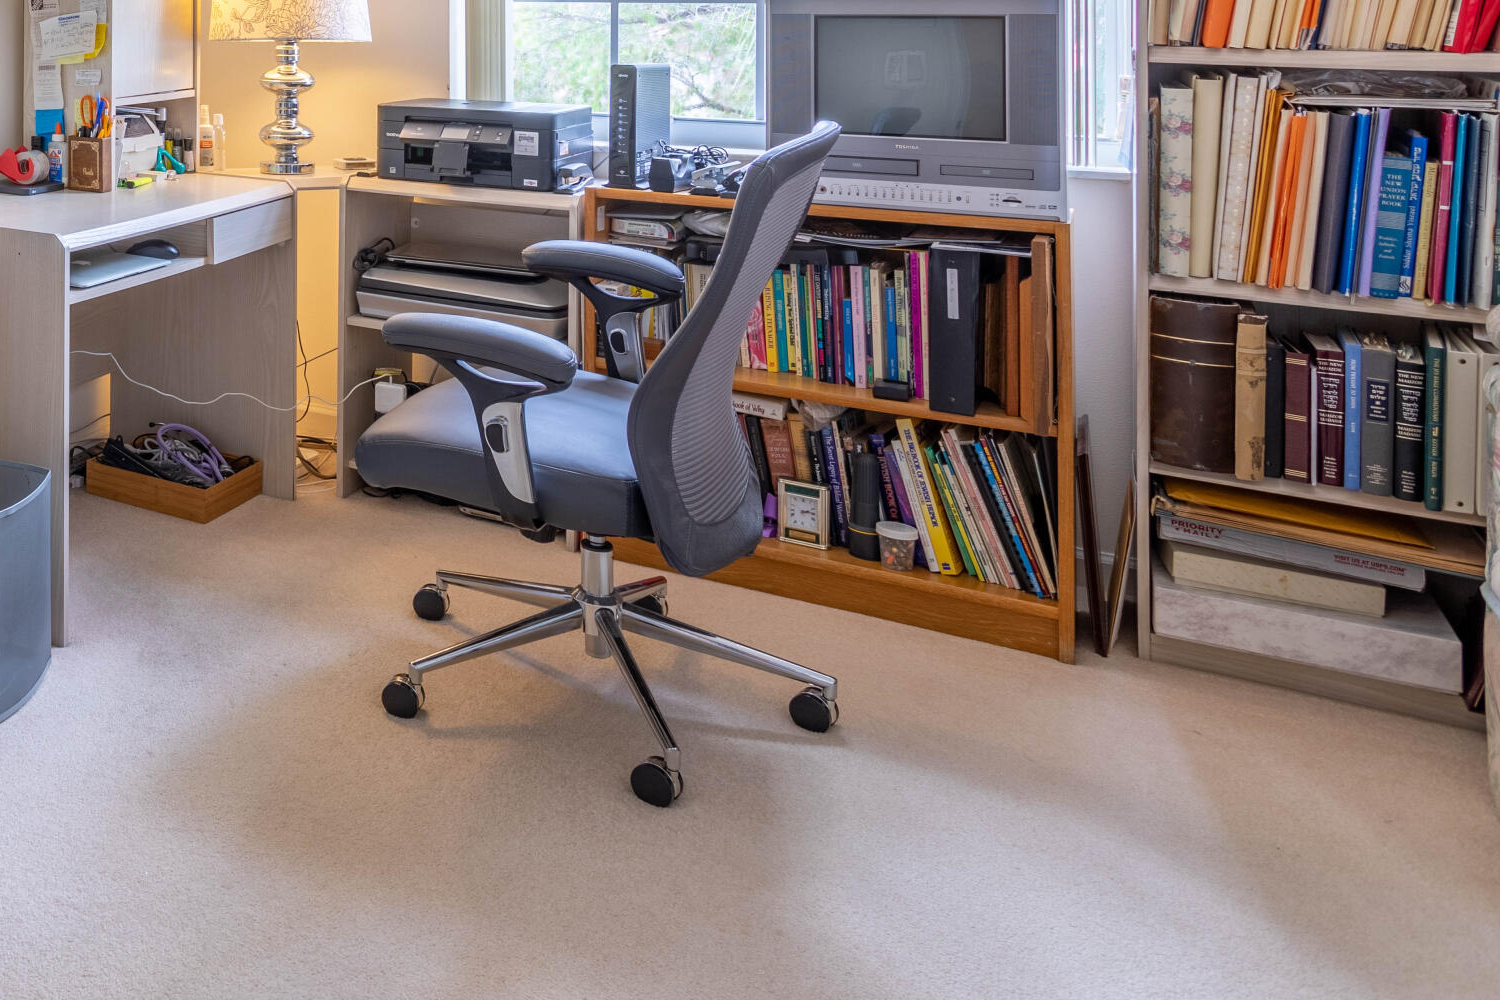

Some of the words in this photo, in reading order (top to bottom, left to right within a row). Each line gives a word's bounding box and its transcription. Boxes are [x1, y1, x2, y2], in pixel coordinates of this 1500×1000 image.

[733, 402, 745, 410] ook
[904, 429, 912, 444] THE
[911, 456, 920, 470] BOOK
[1171, 519, 1224, 535] PRIORITY
[1182, 529, 1214, 538] MAIL
[1334, 554, 1350, 562] VISIT
